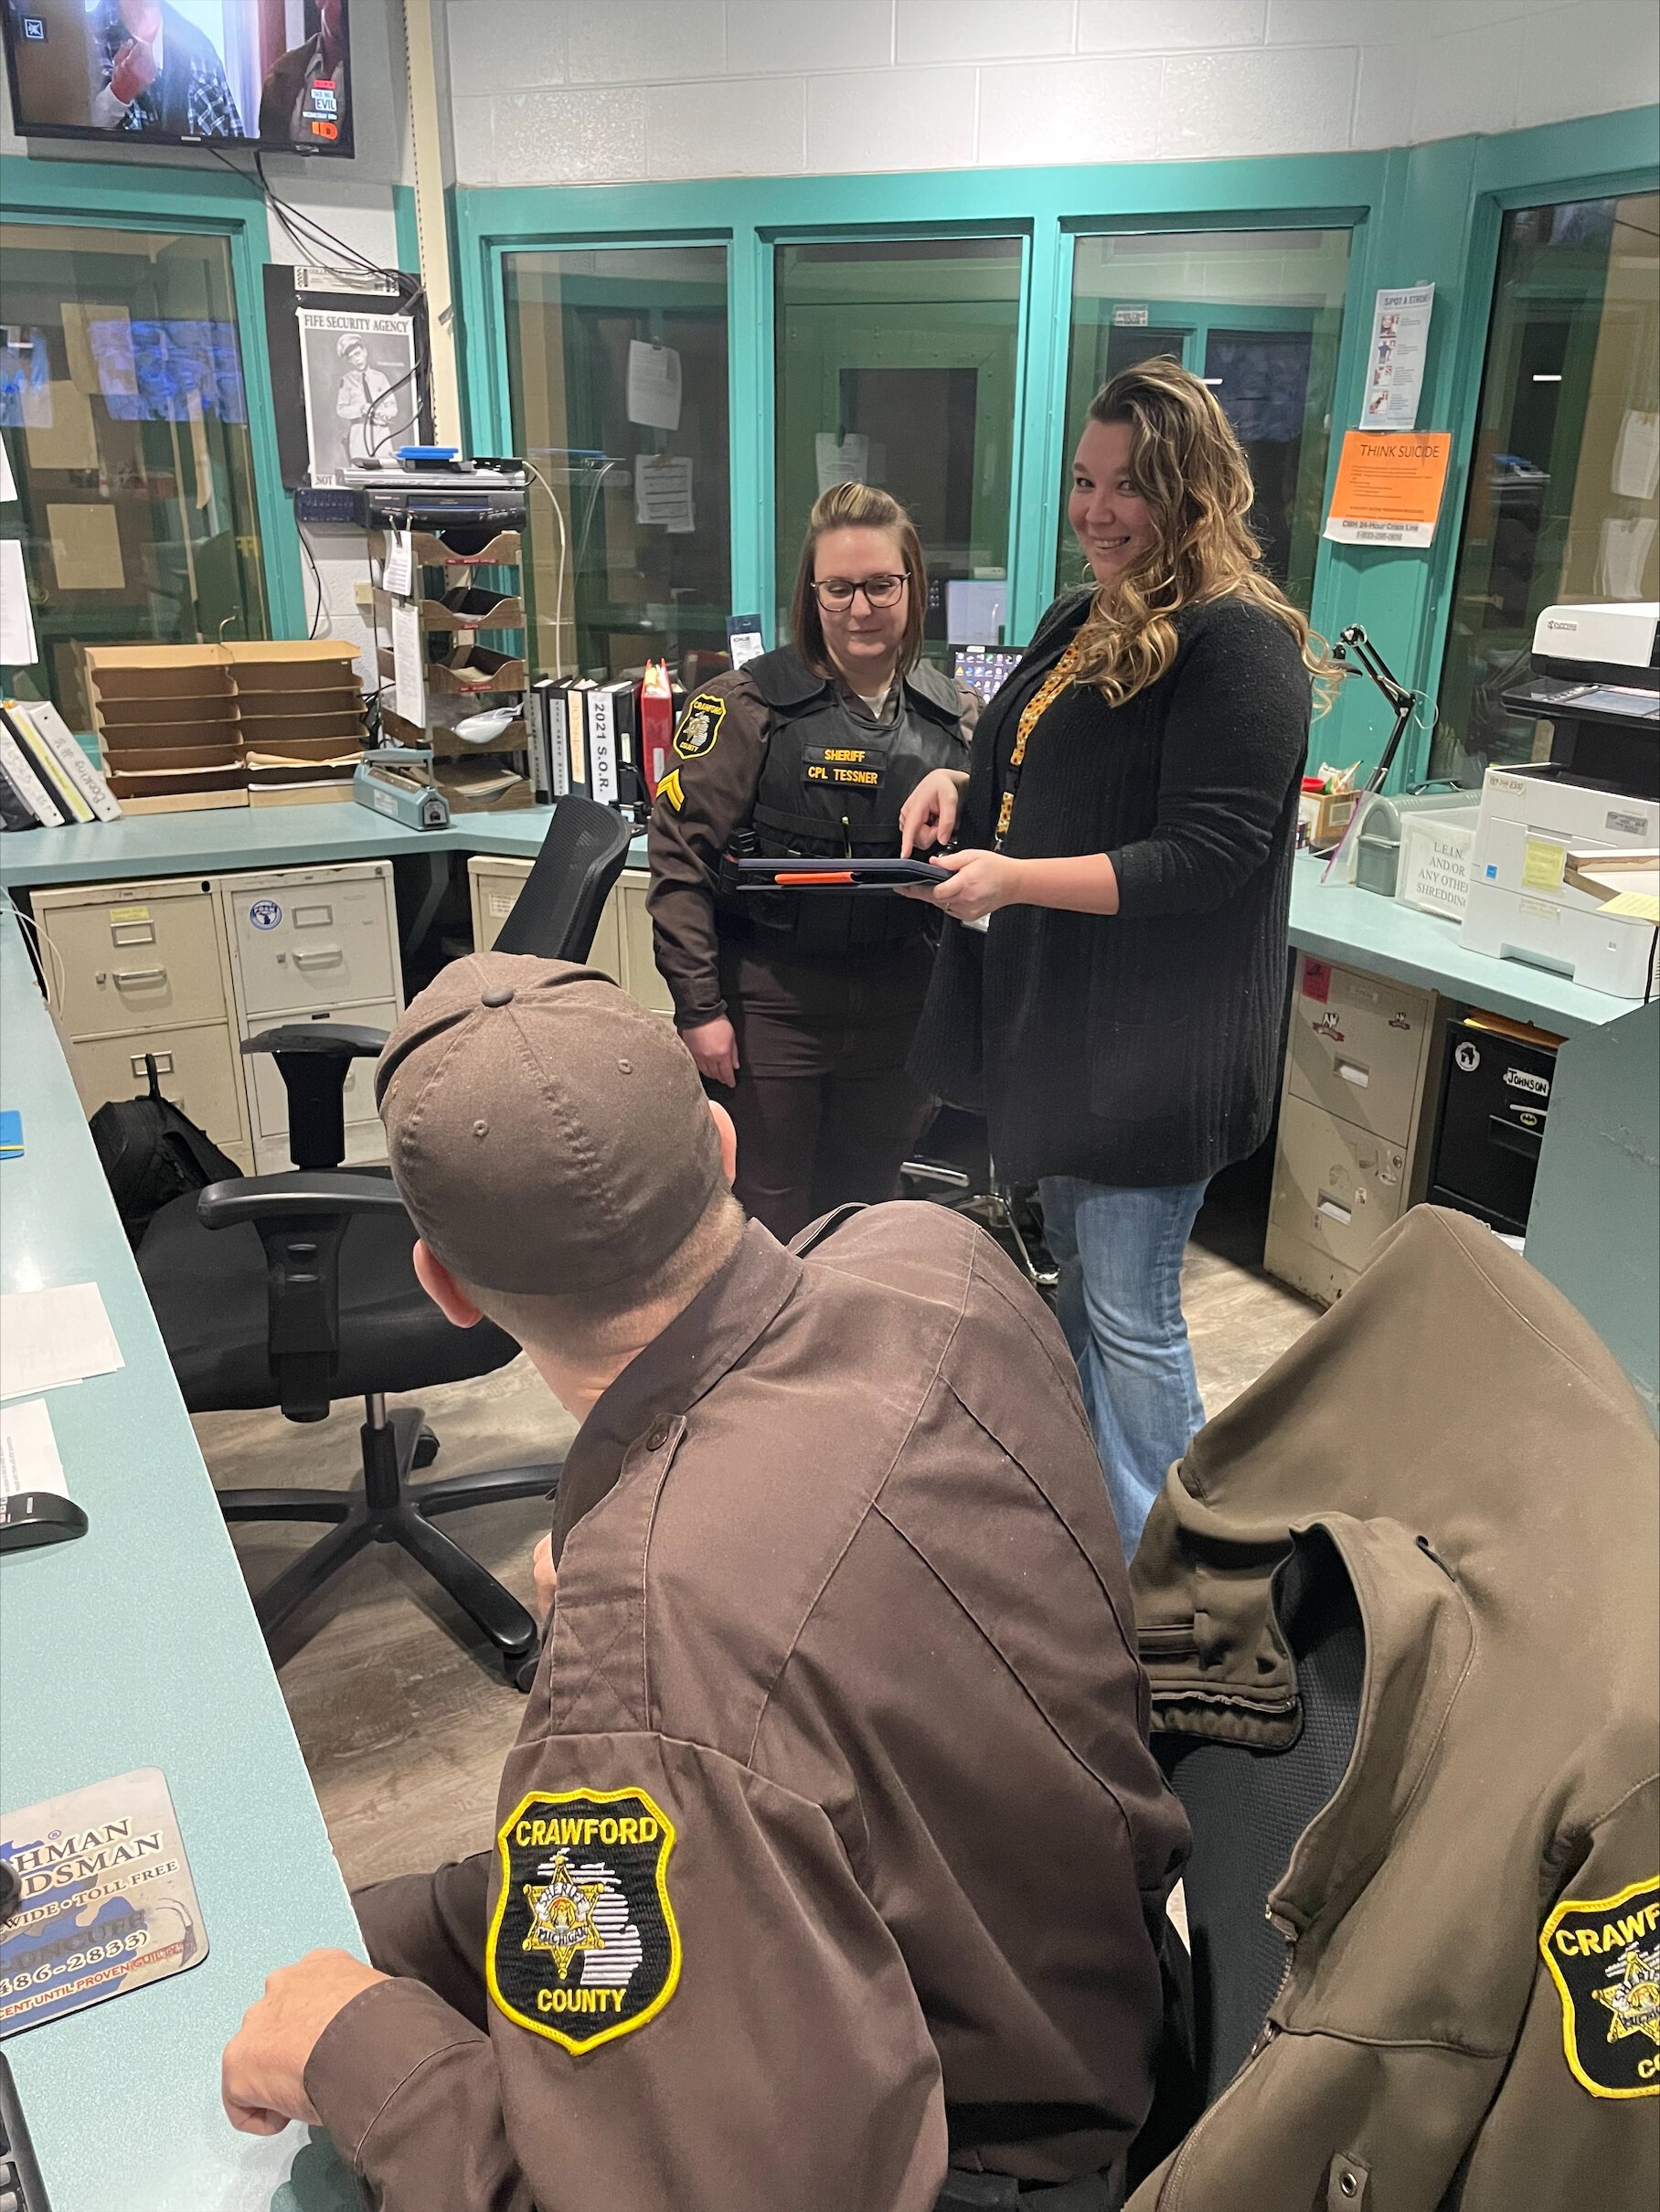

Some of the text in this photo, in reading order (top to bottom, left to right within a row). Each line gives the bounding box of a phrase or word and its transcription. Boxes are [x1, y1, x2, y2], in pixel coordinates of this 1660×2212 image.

[316, 98, 335, 110] EVIL
[312, 121, 338, 140] ID
[1384, 297, 1403, 306] SPOT
[304, 314, 409, 333] FIFE SECURITY AGENCY
[1360, 444, 1440, 458] THINK SUICIDE
[316, 475, 334, 486] NOT
[594, 703, 610, 792] 2021 S.O.R.
[825, 749, 867, 762] SHERIFF
[808, 766, 878, 784] CPL TESSNER
[1419, 868, 1440, 882] ANY
[1508, 1070, 1547, 1093] JOHNSON
[516, 1816, 659, 1846] CRAWFORD
[132, 1860, 178, 1886] FREE
[539, 1927, 586, 1945] MICHIGAN
[35, 1985, 74, 2005] UNTIL
[77, 1962, 130, 1989] PROVEN
[537, 1988, 627, 2013] COUNTY
